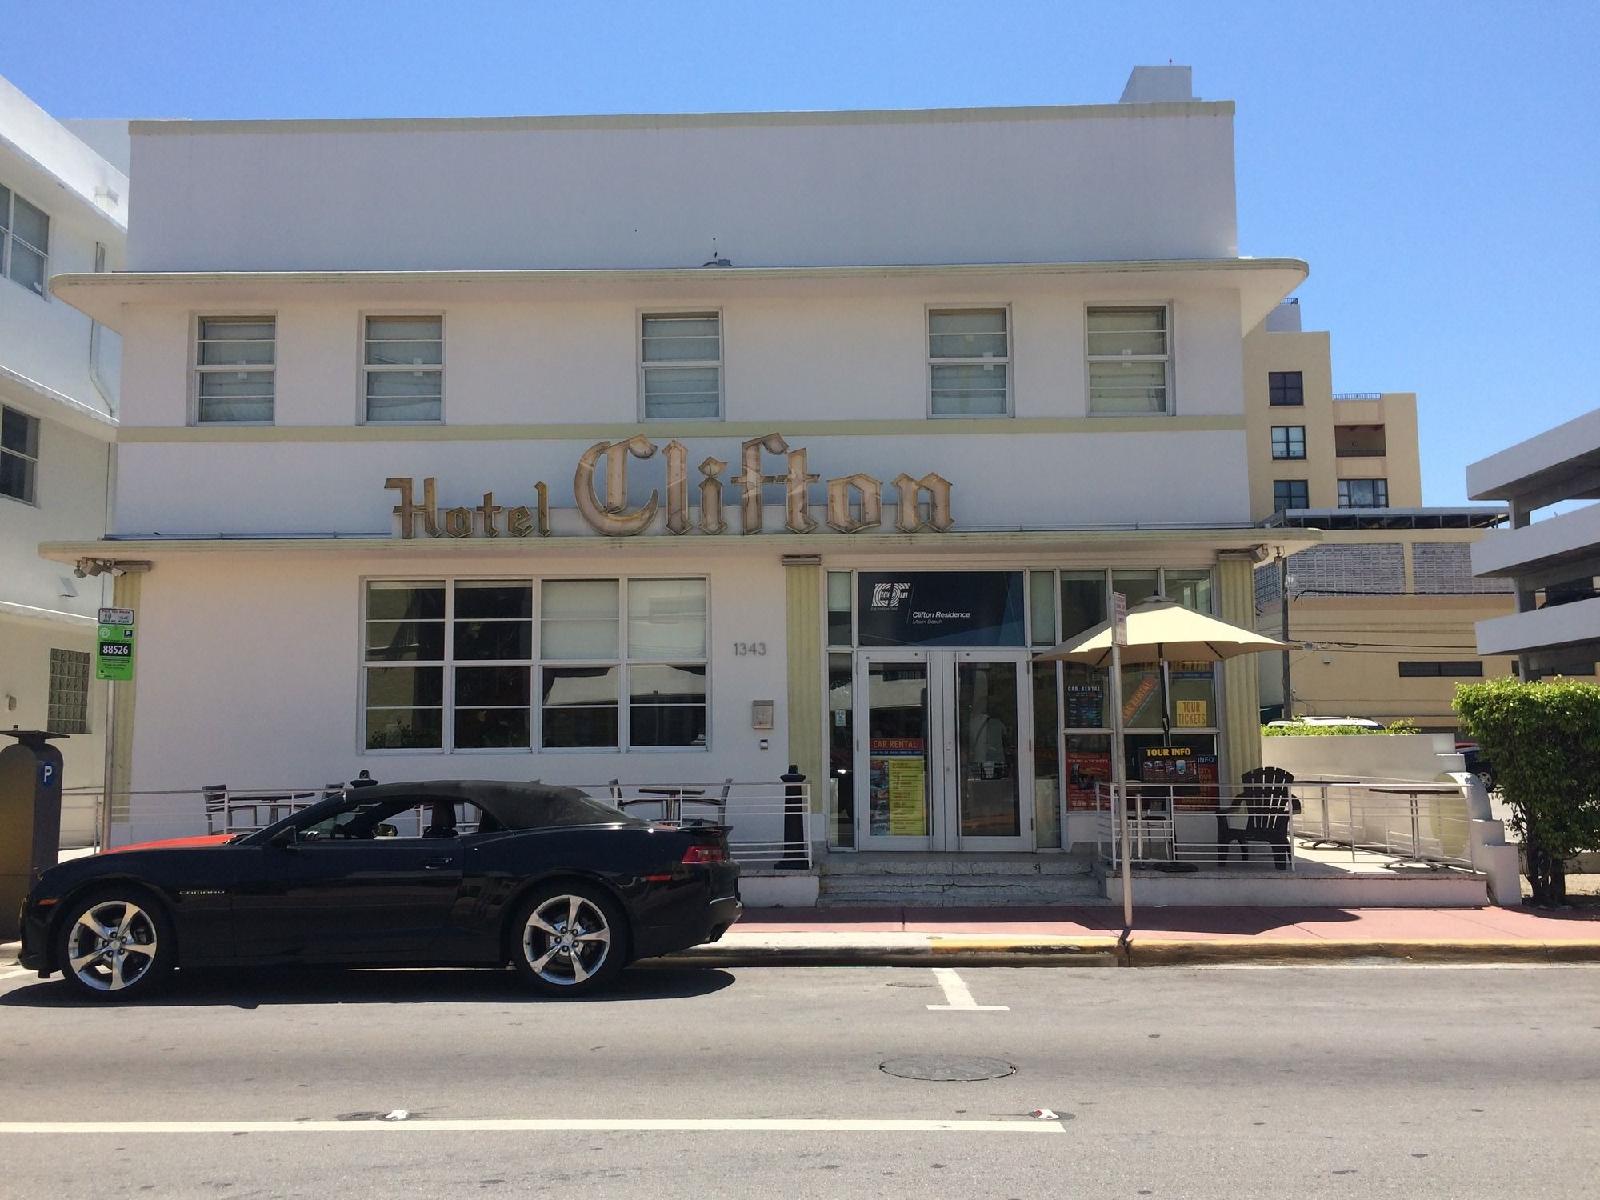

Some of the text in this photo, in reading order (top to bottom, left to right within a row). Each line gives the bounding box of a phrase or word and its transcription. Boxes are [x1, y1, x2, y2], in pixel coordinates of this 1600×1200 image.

[385, 433, 953, 539] Hotel Clifton
[102, 645, 128, 655] 88526
[733, 642, 767, 656] 1343
[1146, 747, 1191, 757] TOUR INFO
[43, 765, 53, 783] P
